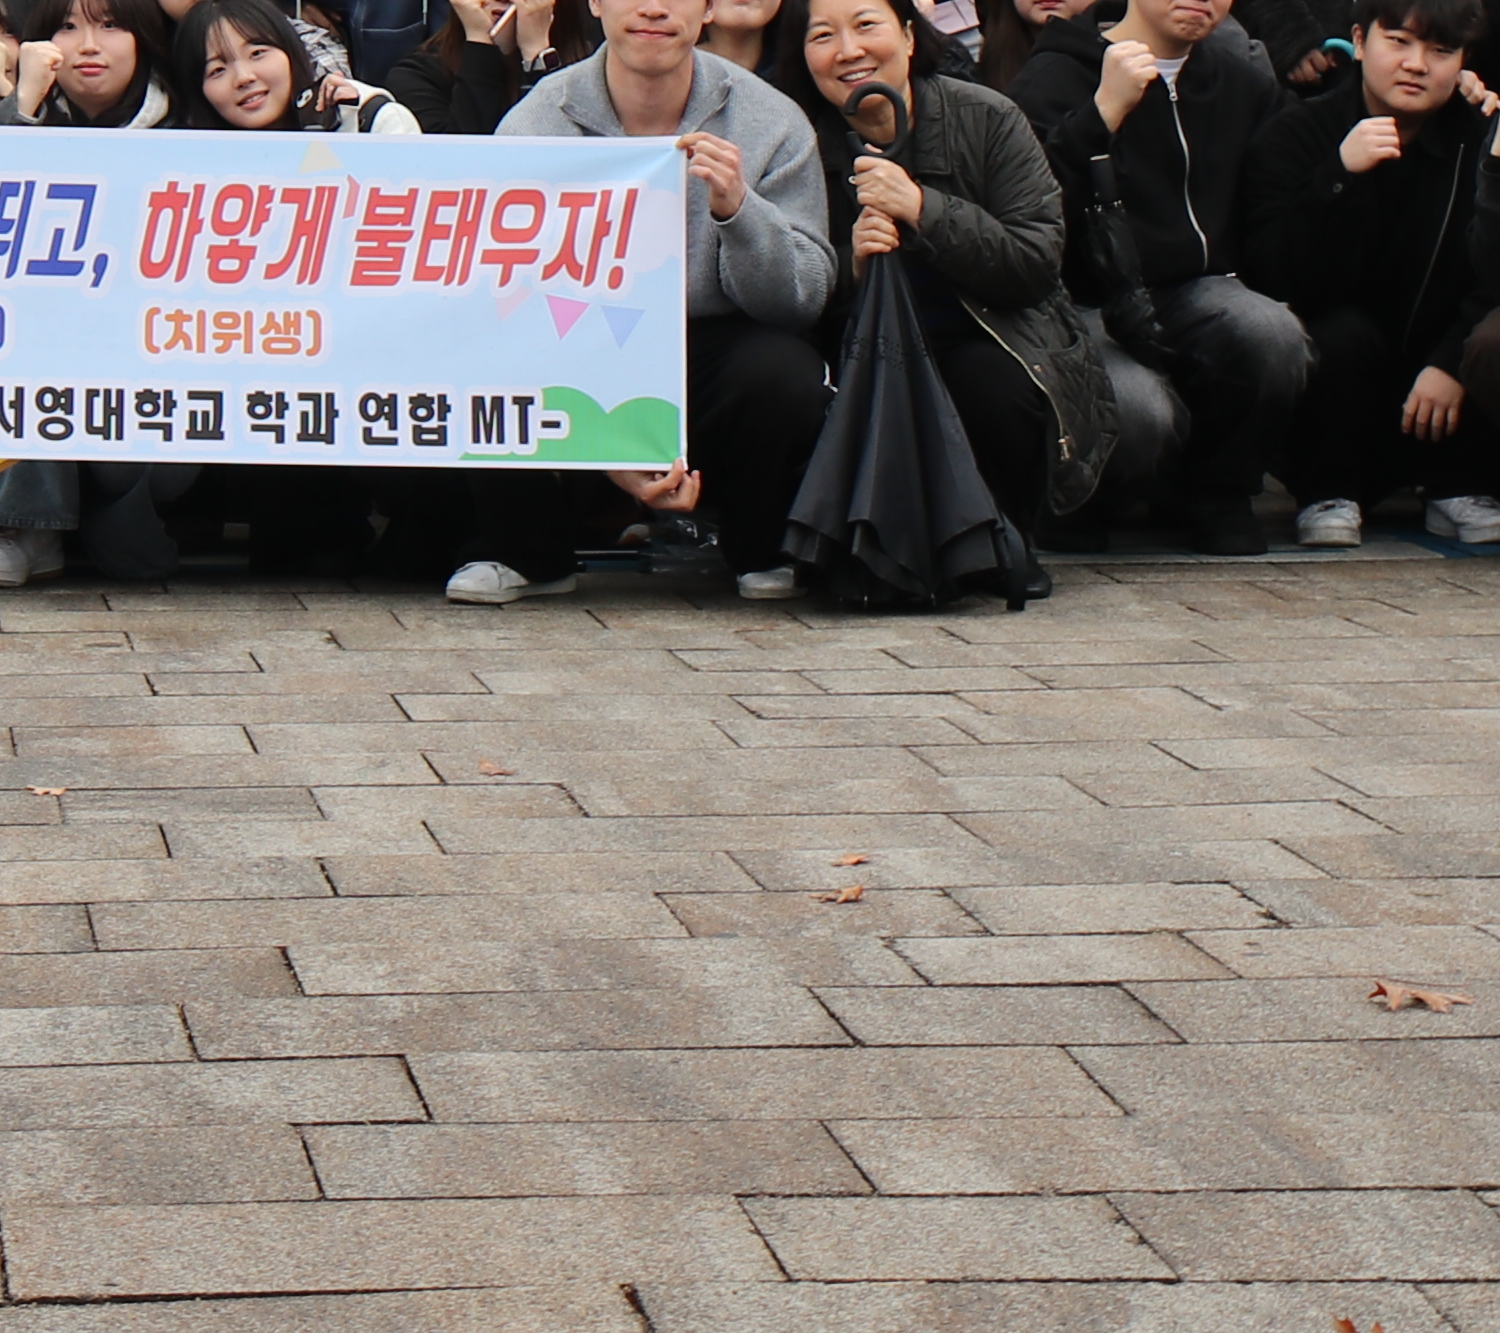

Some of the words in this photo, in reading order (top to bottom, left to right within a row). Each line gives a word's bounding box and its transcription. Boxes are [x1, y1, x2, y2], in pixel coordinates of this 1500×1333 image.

[138, 180, 345, 284] 하얗게
[348, 186, 641, 291] 불태우자!
[144, 307, 322, 357] (치위생)
[246, 390, 340, 446] 학과
[358, 392, 452, 448] 연합
